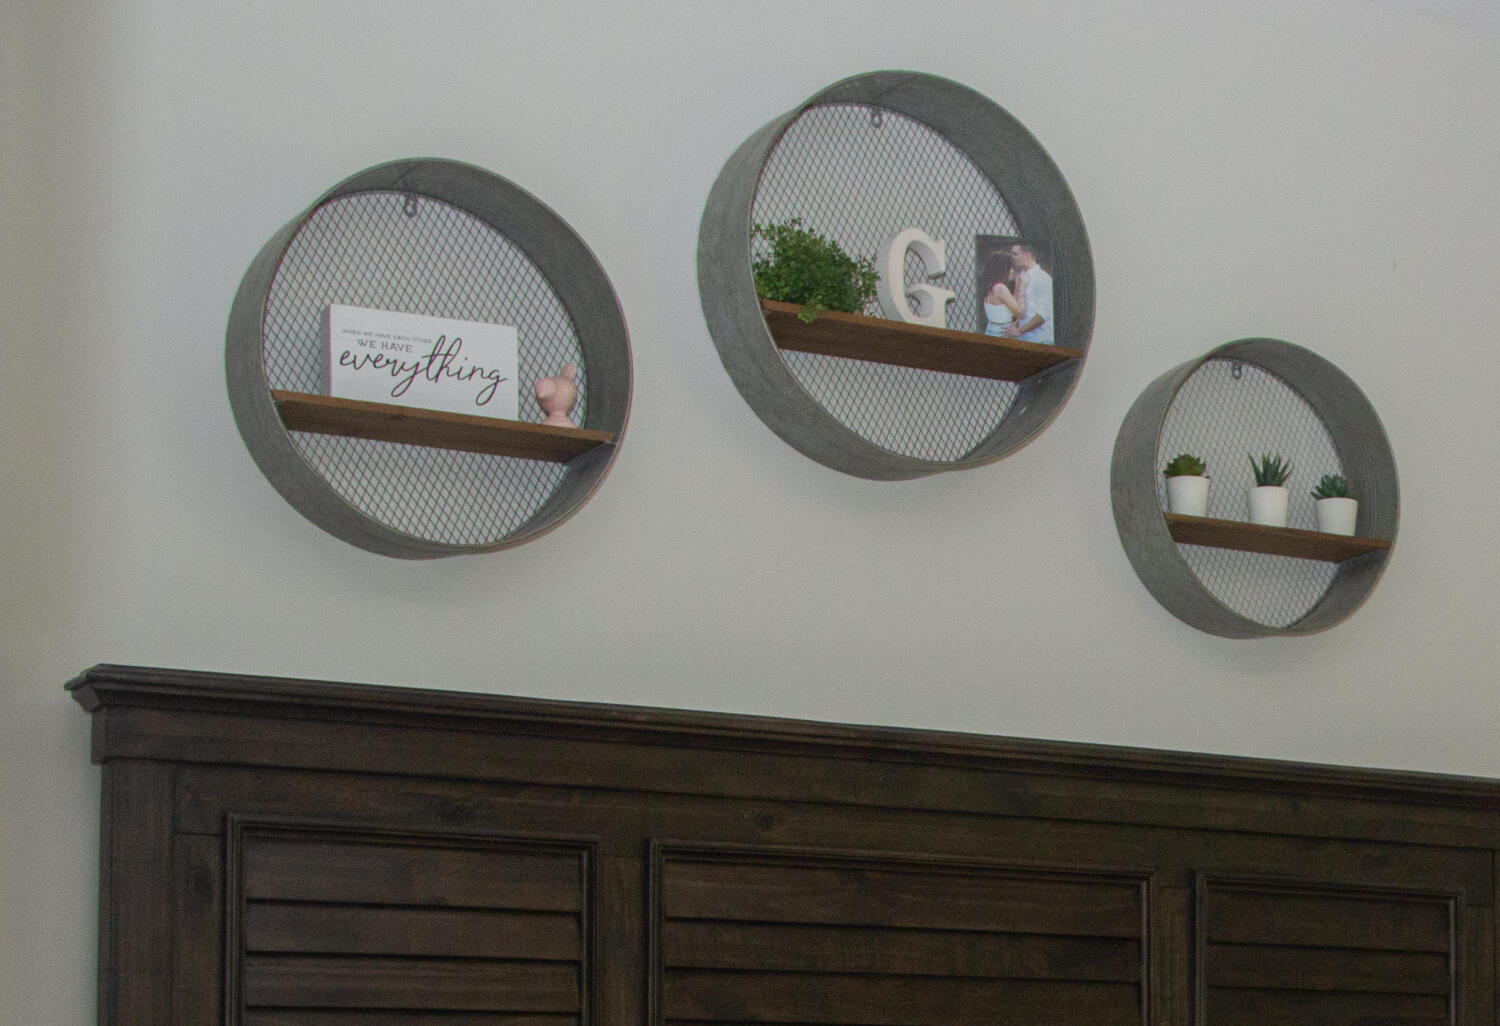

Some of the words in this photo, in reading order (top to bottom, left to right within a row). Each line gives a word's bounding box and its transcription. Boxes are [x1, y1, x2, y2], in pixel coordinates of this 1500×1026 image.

[880, 227, 957, 329] G
[339, 334, 508, 405] everything
[356, 338, 377, 349] WE
[381, 341, 413, 353] HAVE
